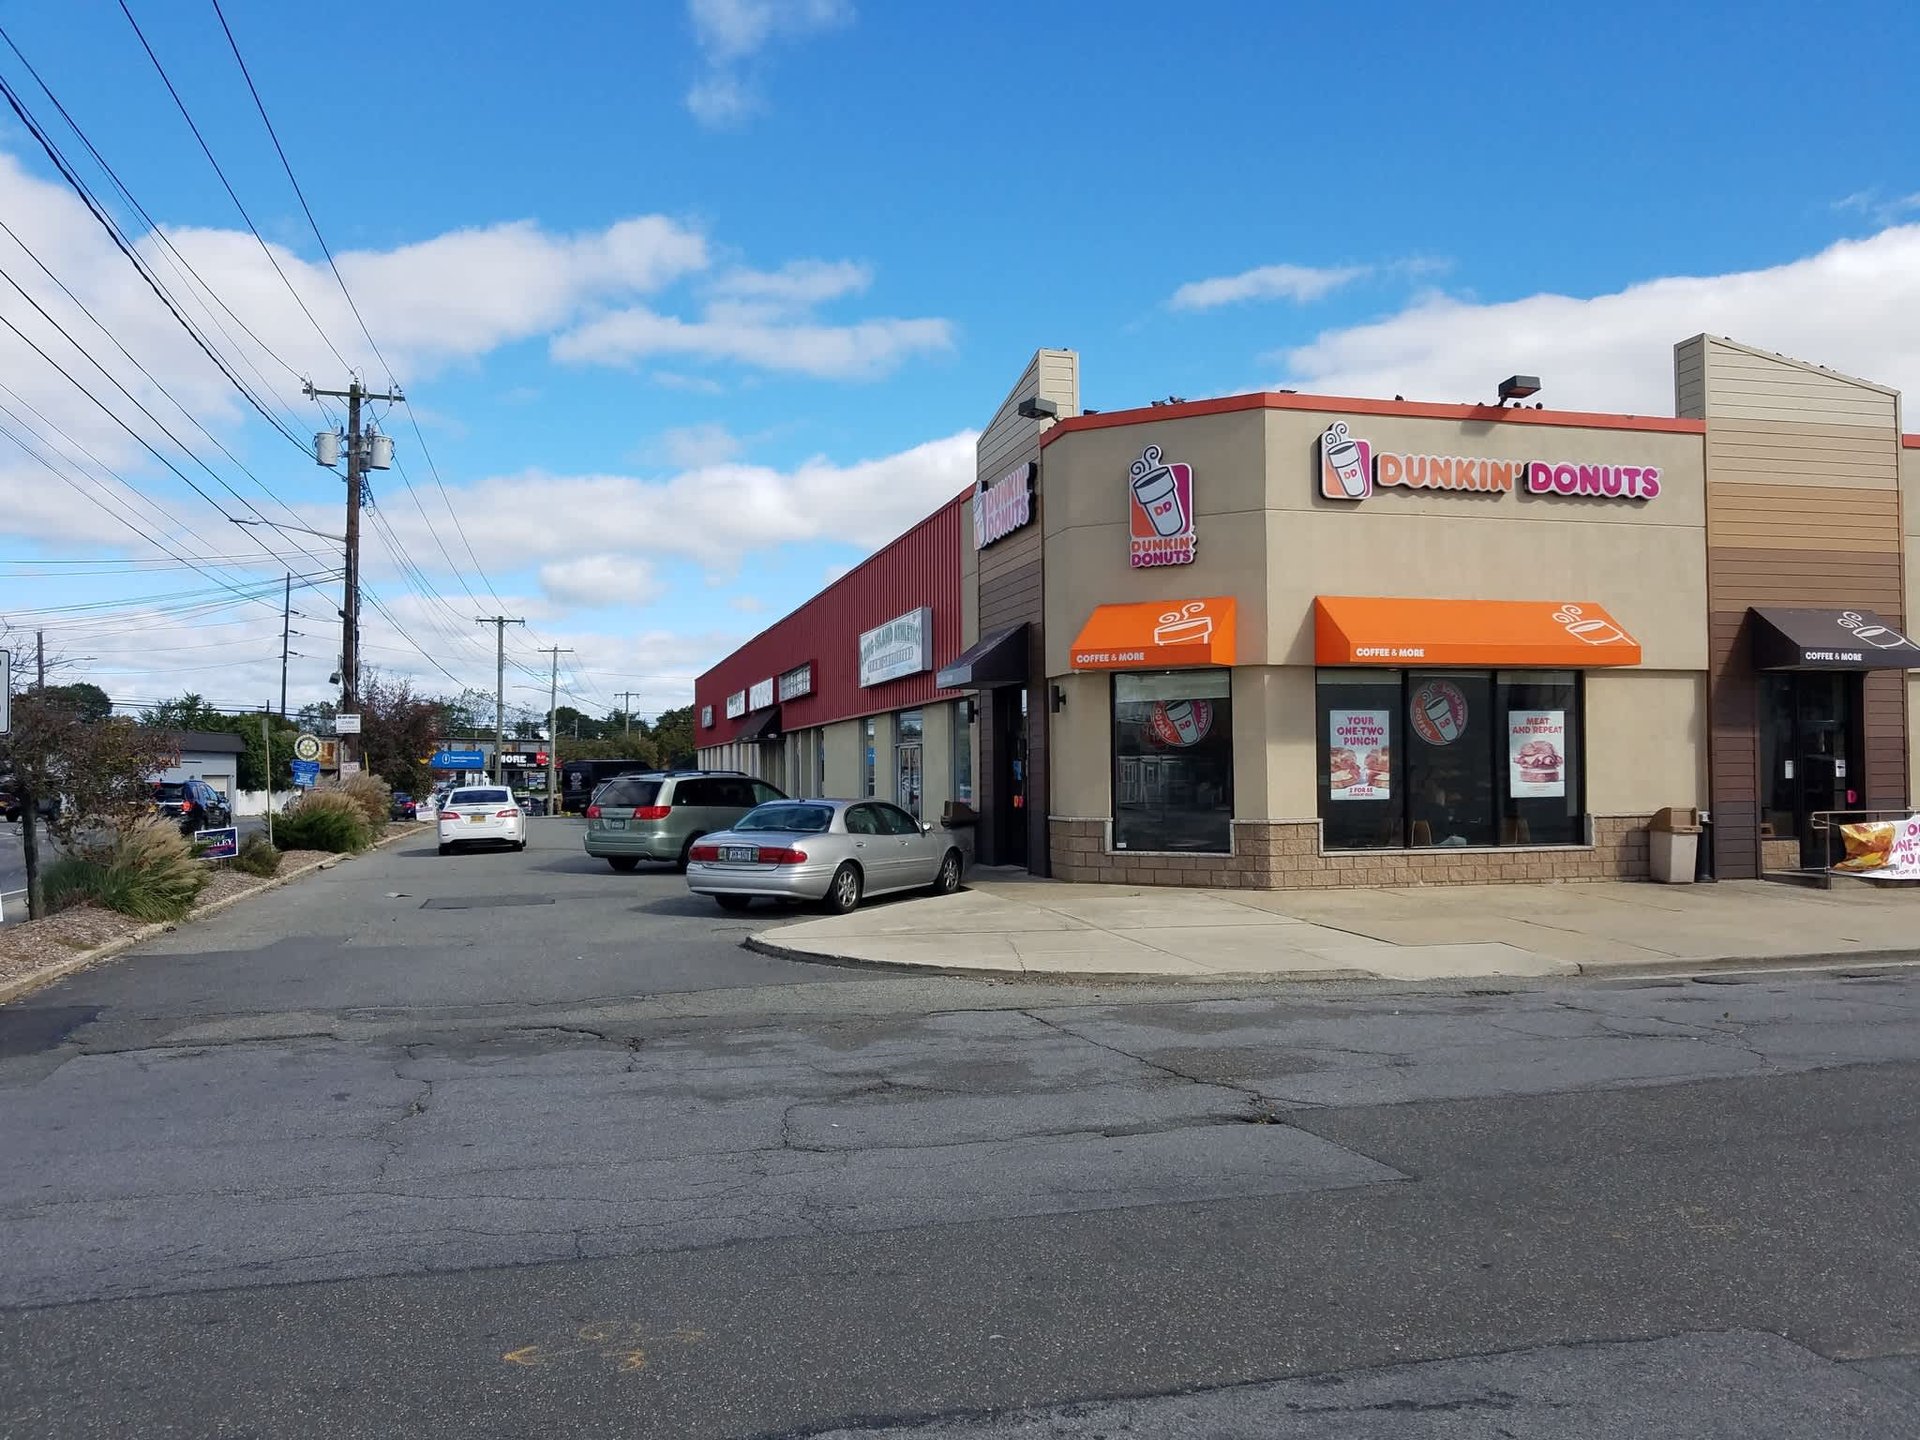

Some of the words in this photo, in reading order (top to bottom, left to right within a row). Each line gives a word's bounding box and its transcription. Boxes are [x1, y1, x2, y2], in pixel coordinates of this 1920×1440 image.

[1344, 469, 1358, 479] DD
[1379, 454, 1523, 490] DUNKIN'
[1530, 462, 1660, 497] DONUTS
[1154, 501, 1172, 516] DD
[1131, 536, 1195, 552] DUNKIN'
[1131, 550, 1191, 566] DONUTS
[1076, 654, 1109, 663] COFFEE
[1111, 653, 1117, 661] &
[1119, 652, 1145, 661] MORE
[1356, 648, 1390, 657] COFFEE
[1391, 648, 1397, 657] &
[1399, 648, 1425, 658] MORE
[1805, 652, 1834, 660] COFFEE
[1834, 652, 1840, 660] &
[1840, 652, 1863, 661] MORE
[1347, 716, 1374, 725] YOUR
[1526, 717, 1550, 725] MEAT
[1337, 727, 1384, 735] ONE-TWO
[1513, 726, 1531, 734] AND
[1533, 726, 1563, 734] REPEAT
[1344, 737, 1378, 746] PUNCH
